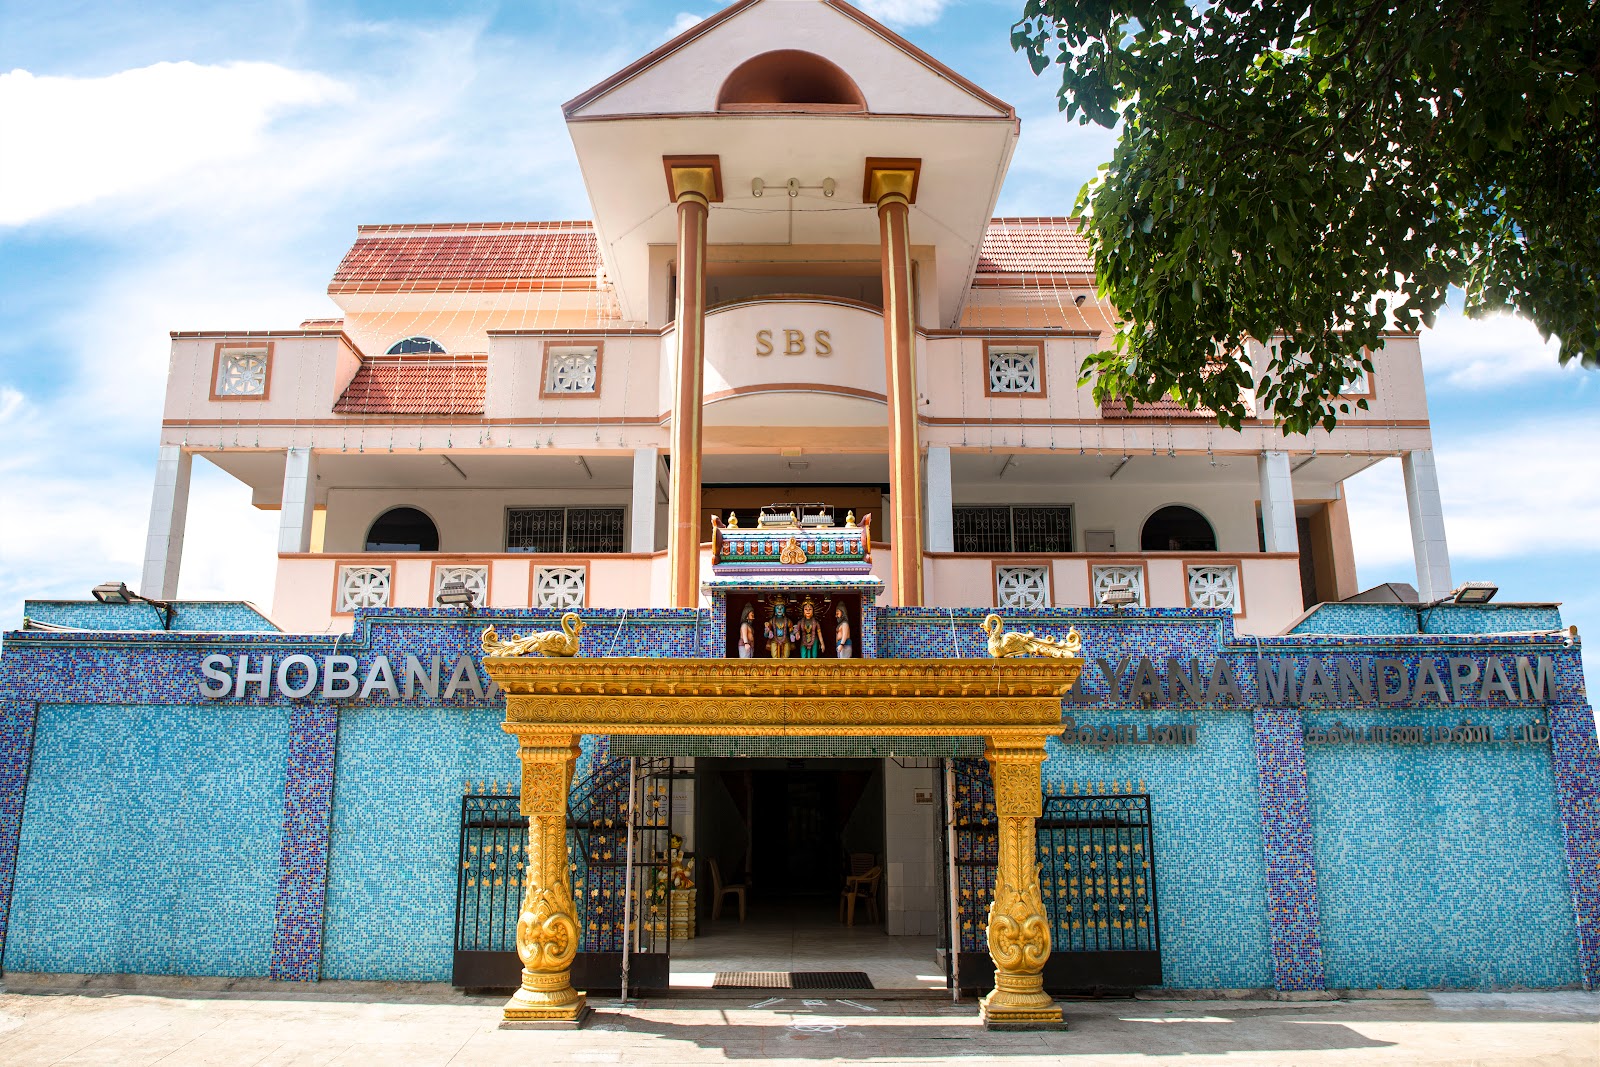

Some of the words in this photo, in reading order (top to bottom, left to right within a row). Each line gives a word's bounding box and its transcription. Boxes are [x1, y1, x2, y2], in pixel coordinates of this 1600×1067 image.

[756, 329, 832, 357] SBS
[200, 654, 499, 699] SHOBANA
[1064, 656, 1243, 702] LYANA
[1257, 655, 1556, 702] MANDAPAM
